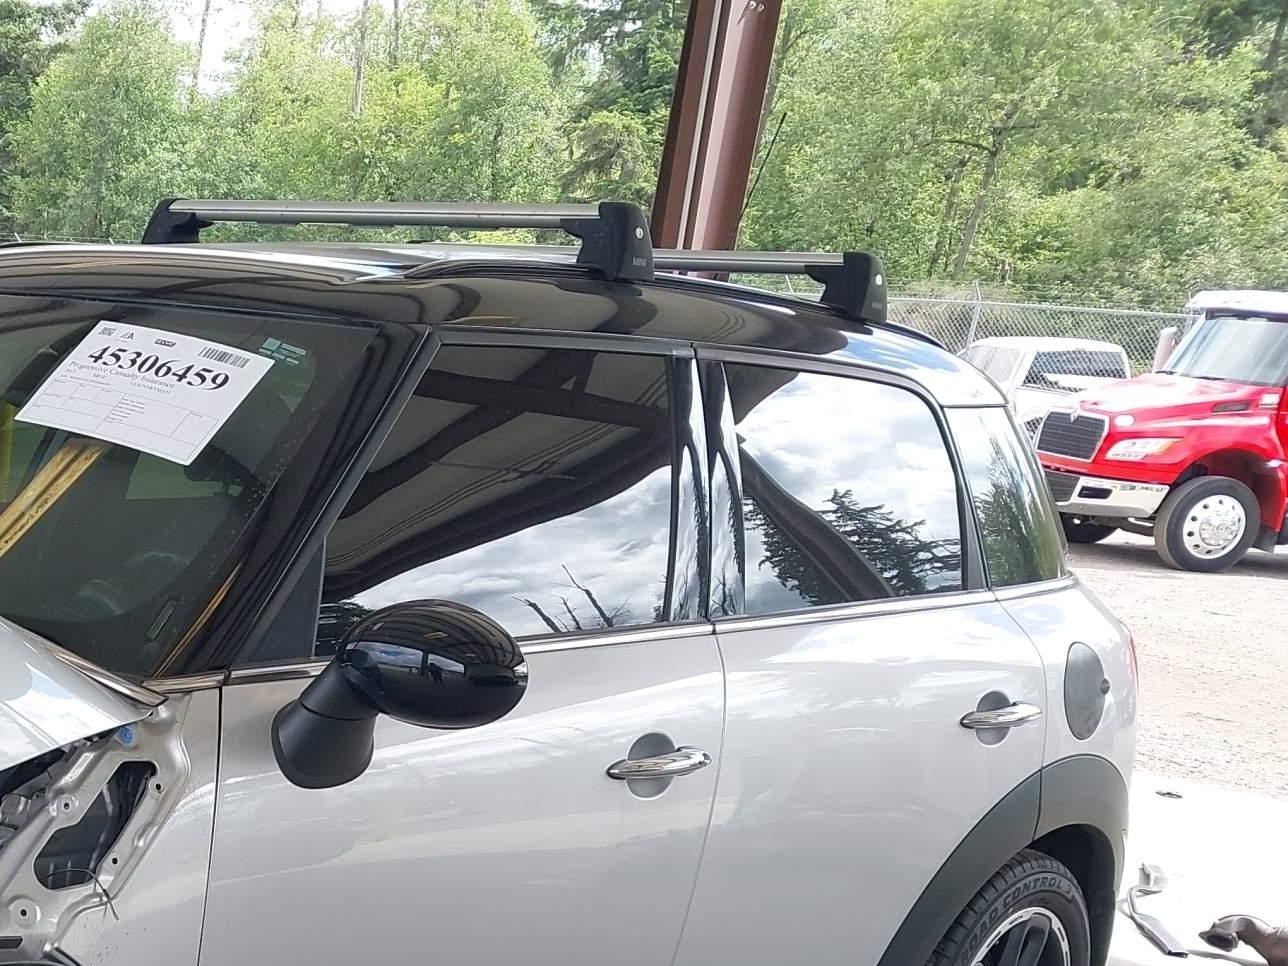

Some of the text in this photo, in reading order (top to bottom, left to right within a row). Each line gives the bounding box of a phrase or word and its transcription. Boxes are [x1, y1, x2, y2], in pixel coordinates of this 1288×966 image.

[88, 345, 230, 391] 45306459
[109, 368, 140, 380] Casualty
[140, 375, 176, 388] Insurance
[1004, 877, 1062, 908] CONTROL
